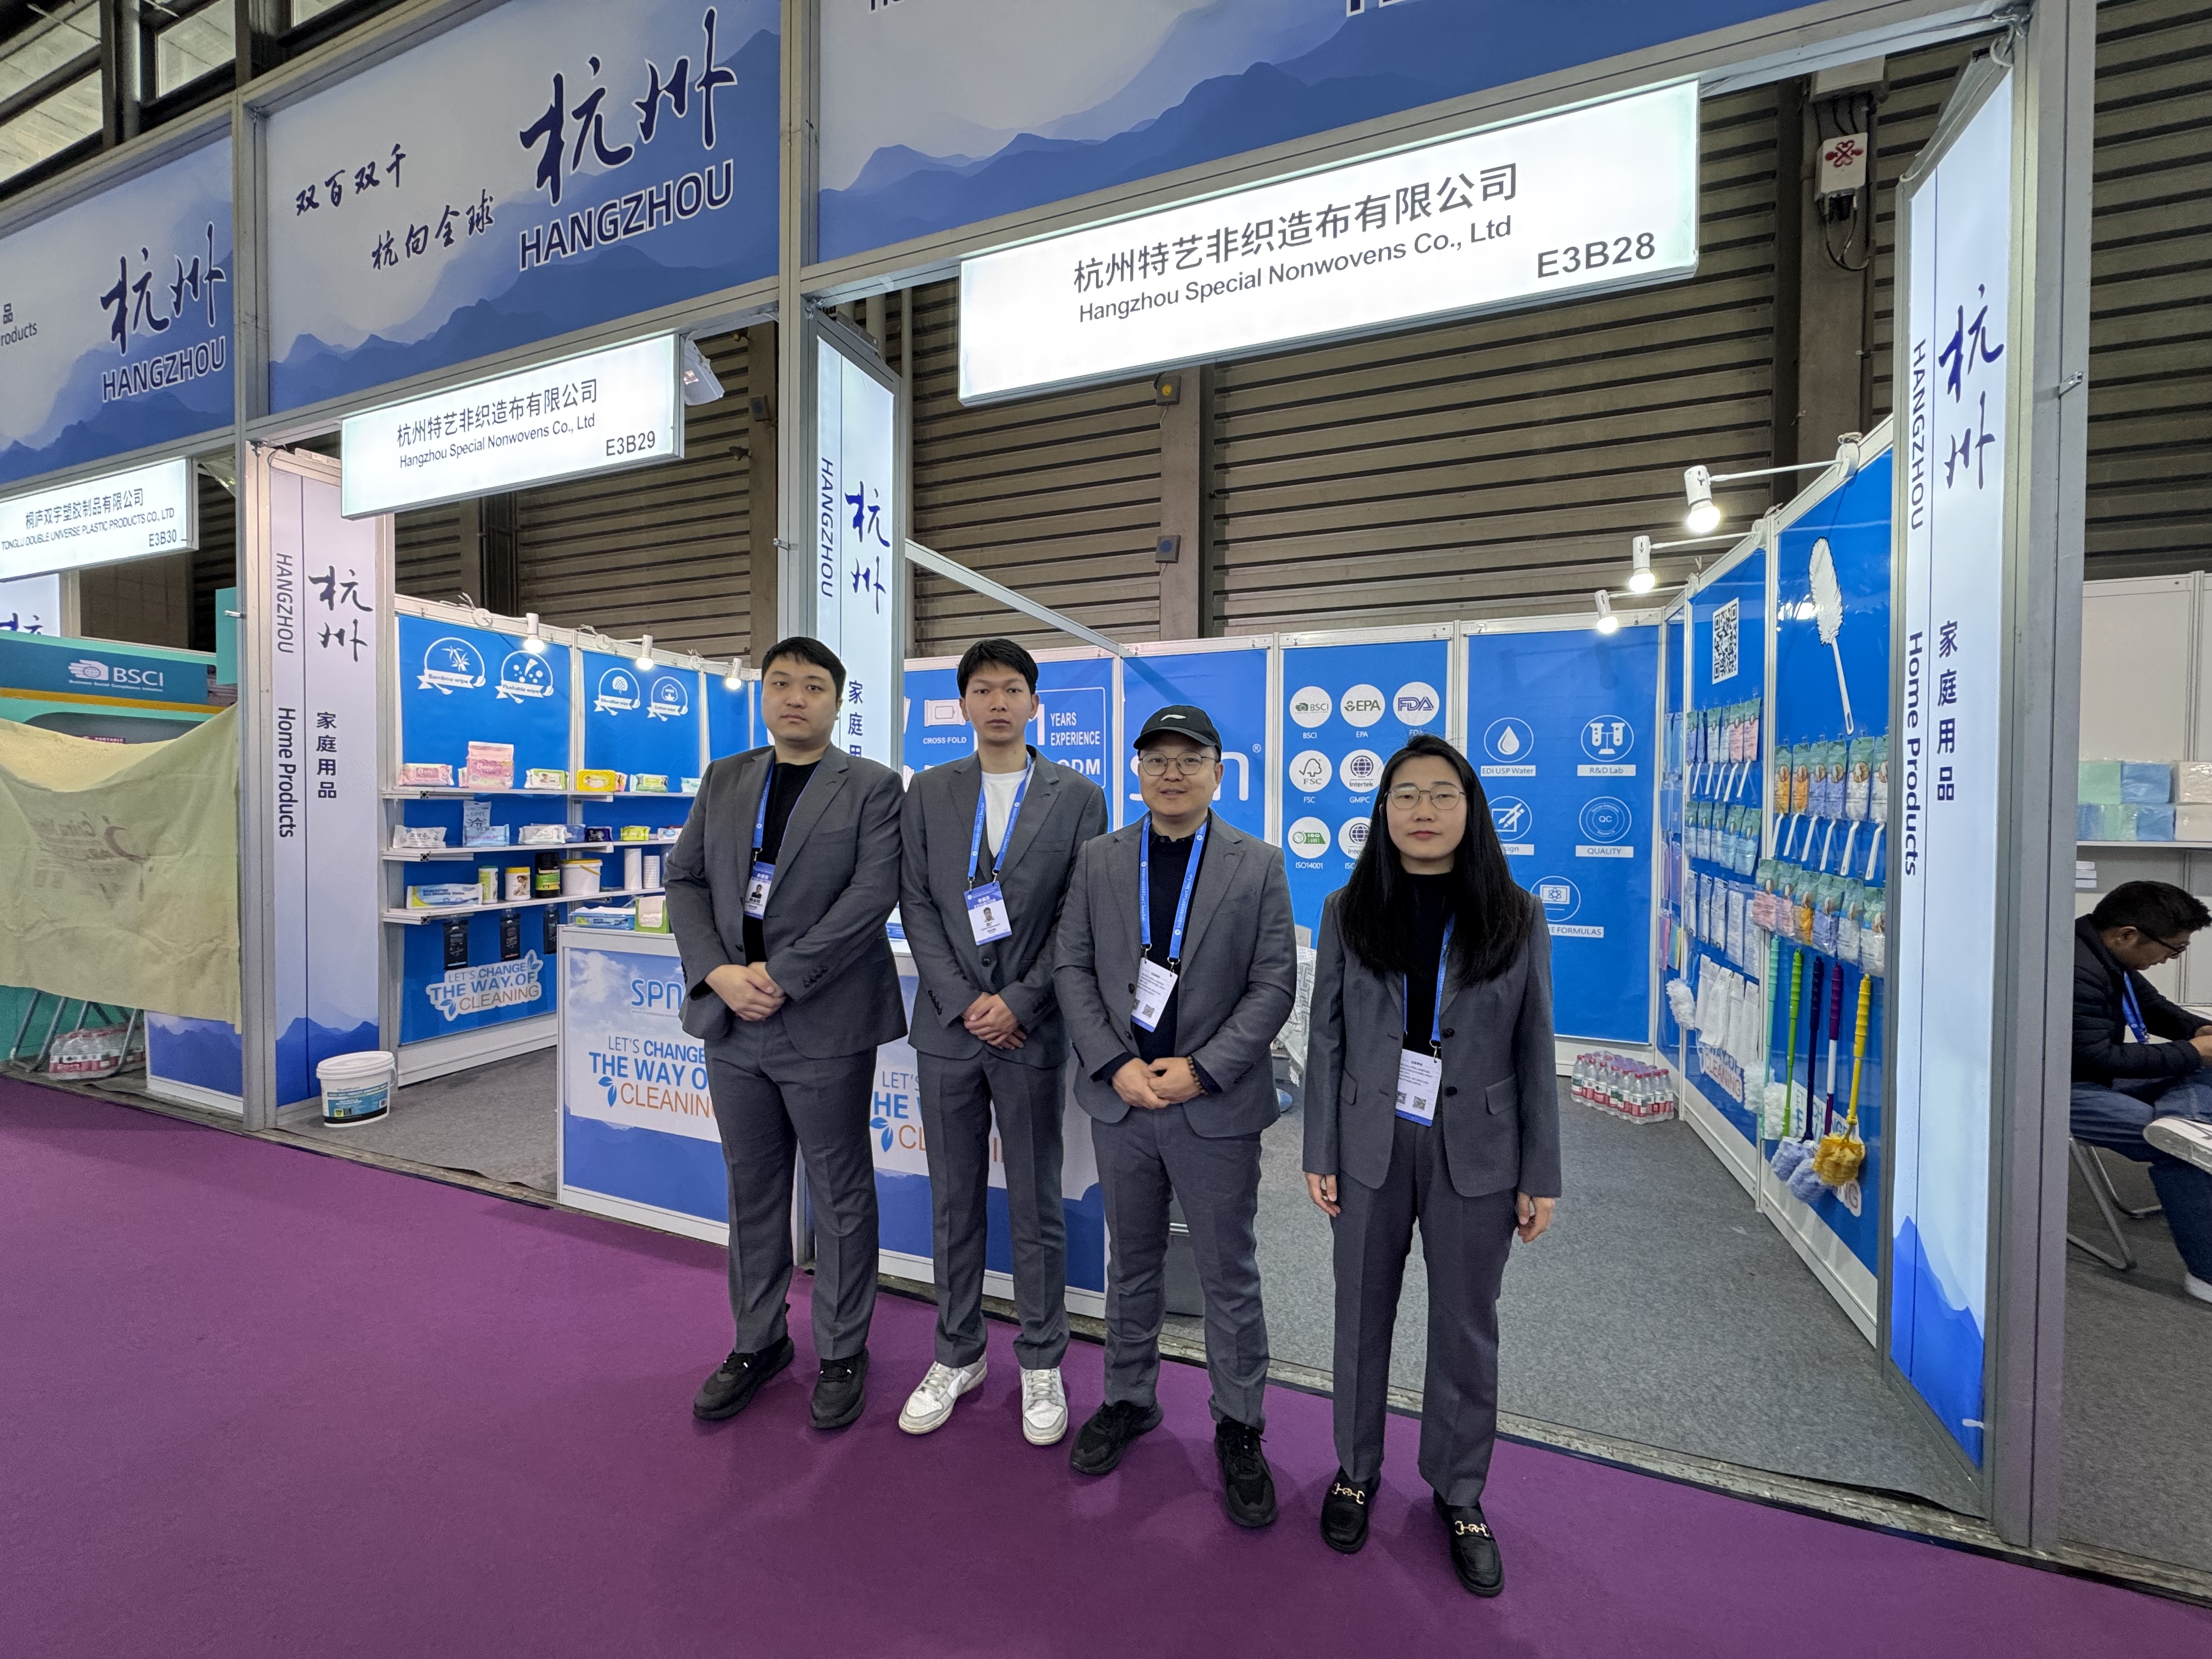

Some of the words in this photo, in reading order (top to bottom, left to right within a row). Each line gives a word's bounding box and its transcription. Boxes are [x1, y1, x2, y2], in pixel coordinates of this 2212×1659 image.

[520, 7, 737, 205] 杭州
[296, 144, 407, 216] 双百双千
[520, 159, 735, 271] HANGZHOU
[1073, 162, 1518, 295] 杭州特艺非织造布有限公司
[1079, 285, 1179, 323] Hangzhou
[1185, 267, 1262, 304] Special
[1268, 240, 1407, 285] Nonwovens
[1413, 231, 1462, 258] Co.,
[1470, 215, 1511, 244] Ltd
[1537, 233, 1656, 279] E3B28
[100, 221, 226, 355] 杭州
[1, 323, 37, 347] roducts
[103, 336, 226, 402] HANGZHOU
[1938, 283, 2004, 490] 杭州
[397, 379, 597, 448] 杭州特艺非织造布有限公司
[1911, 338, 1926, 531] HANGZHOU
[399, 448, 447, 469] Hangzhou
[449, 437, 485, 459] Special
[488, 427, 549, 449] Nonwovens
[577, 413, 595, 430] Ltd
[606, 430, 656, 457] E3B29
[82, 521, 108, 535] PLASTIC
[109, 514, 145, 530] PRODUCTS
[162, 507, 174, 521] LTD
[149, 529, 177, 547] E3B30
[821, 456, 834, 598] HANGZHOU
[845, 481, 890, 614] 杭州
[276, 552, 294, 653] HANGZHOU
[308, 566, 373, 662] 杭州
[114, 667, 163, 686] BSCI
[1907, 631, 1923, 729] Home
[848, 680, 863, 757] 家庭用
[1050, 712, 1077, 727] YEARS
[1310, 703, 1329, 712] BSCI
[1356, 700, 1381, 712] EPA
[1397, 697, 1435, 712] FDA
[1937, 620, 1958, 801] 家庭用品
[278, 708, 296, 758] Home
[316, 712, 337, 799] 家庭用品
[947, 736, 967, 744] FOLD
[1051, 731, 1100, 746] EXPERIENCE
[279, 763, 298, 838] Products
[1905, 737, 1921, 876] Products
[1557, 926, 1602, 936] FORMULAS
[430, 983, 466, 1001] THE
[471, 976, 510, 993] WAY
[515, 972, 535, 985] OF
[448, 970, 475, 983] LET'S
[478, 962, 527, 978] CHANGE
[459, 985, 539, 1011] CLEANING
[608, 1036, 640, 1053] LET'S
[589, 1052, 628, 1078] THE
[634, 1058, 686, 1087] WAY
[692, 1067, 708, 1090] O
[1705, 1053, 1741, 1098] CLEANING
[620, 1082, 715, 1118] CLEANIN
[874, 1092, 909, 1119] HE
